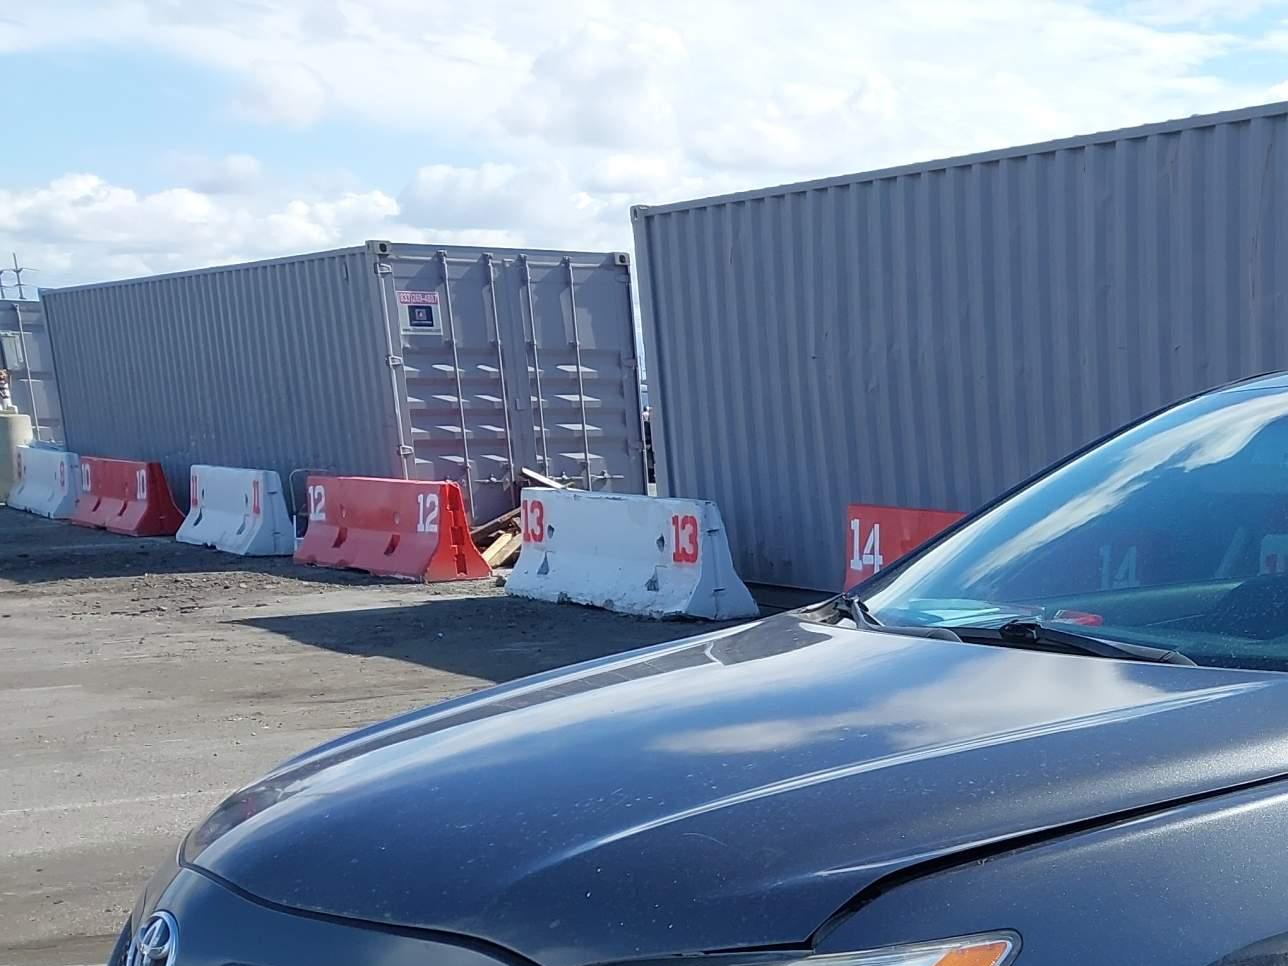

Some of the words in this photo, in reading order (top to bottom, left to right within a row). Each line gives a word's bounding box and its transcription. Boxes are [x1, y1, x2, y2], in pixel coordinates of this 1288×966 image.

[81, 463, 91, 492] 10
[136, 470, 147, 499] 10
[191, 475, 198, 507] 11
[252, 480, 261, 514] 11
[308, 485, 326, 521] 12
[417, 493, 439, 532] 12
[522, 499, 544, 543] 13
[672, 515, 699, 564] 13
[850, 518, 883, 575] 14
